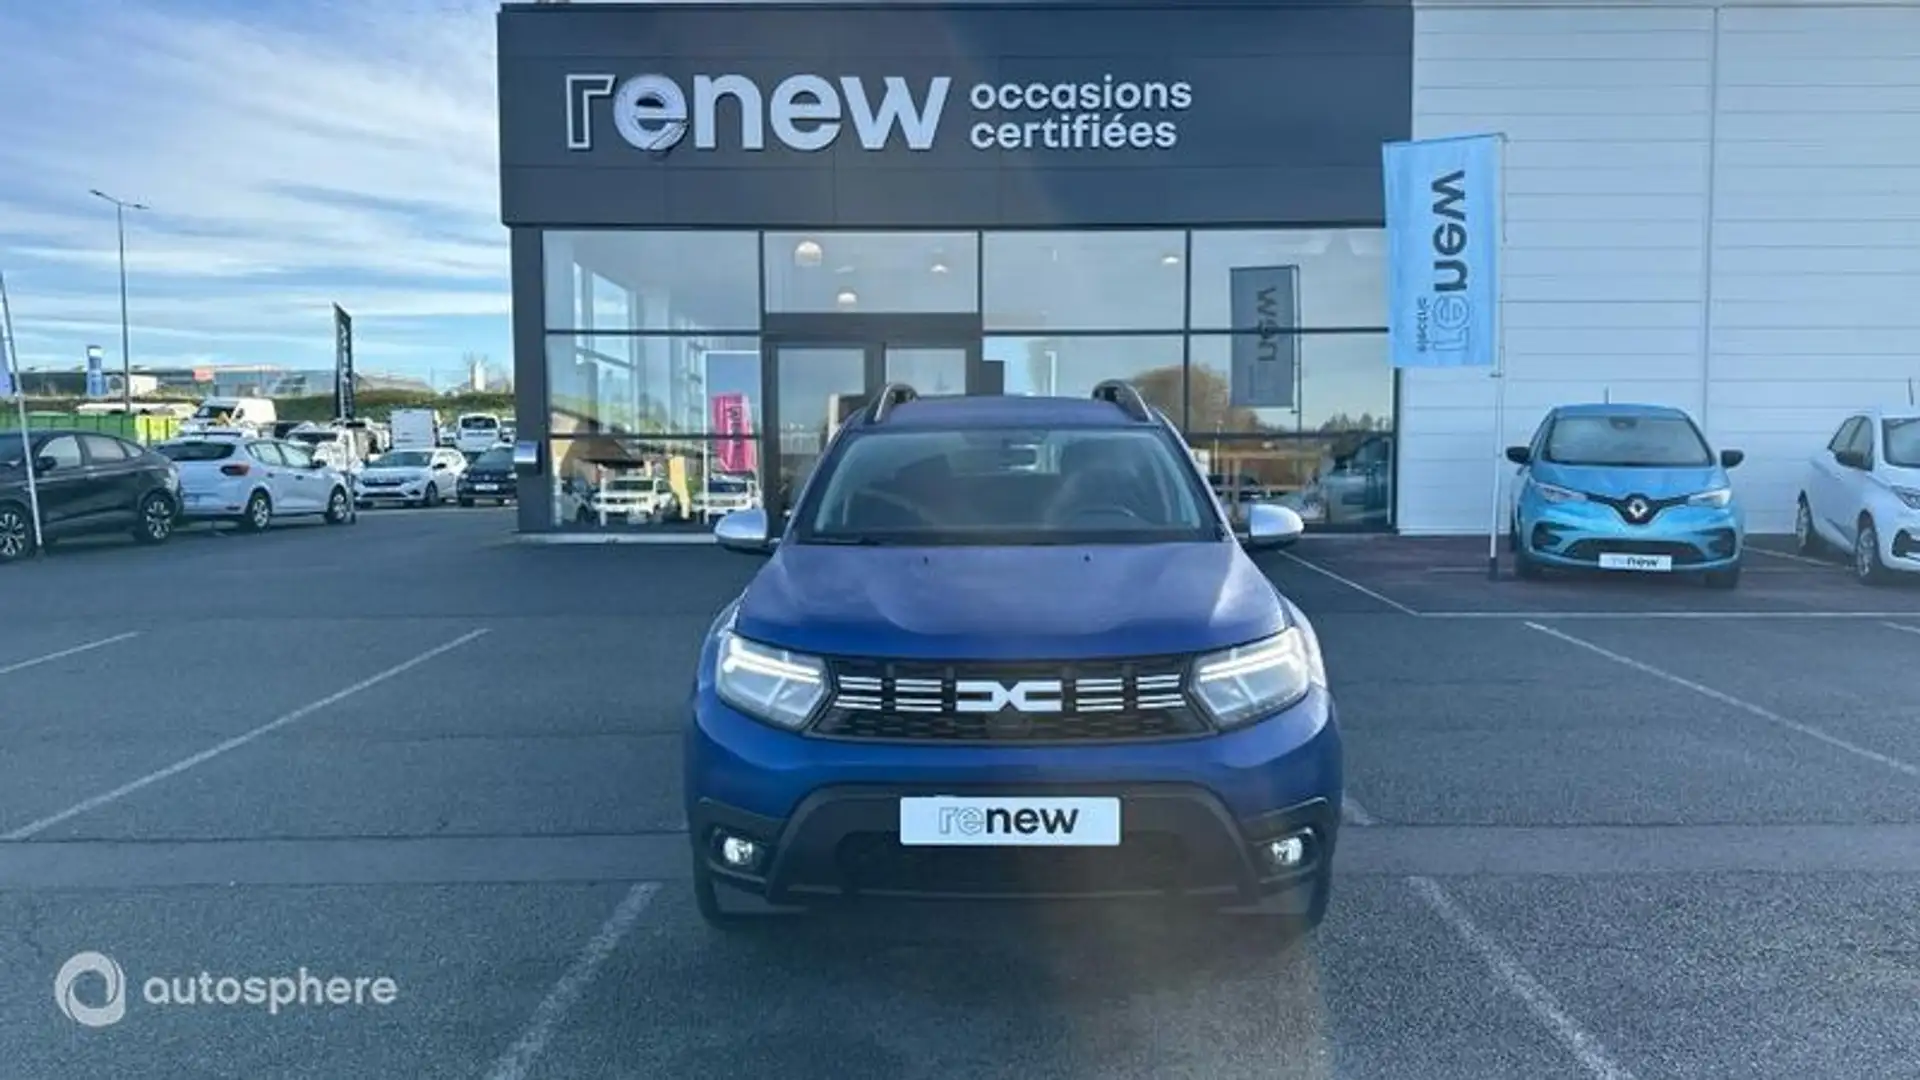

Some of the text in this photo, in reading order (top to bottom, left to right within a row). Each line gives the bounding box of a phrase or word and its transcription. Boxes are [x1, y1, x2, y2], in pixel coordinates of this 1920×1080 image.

[970, 74, 1192, 111] occasions
[565, 73, 952, 151] renew
[970, 114, 1177, 150] certifiées
[1611, 557, 1658, 568] rnew
[938, 806, 1080, 836] renew
